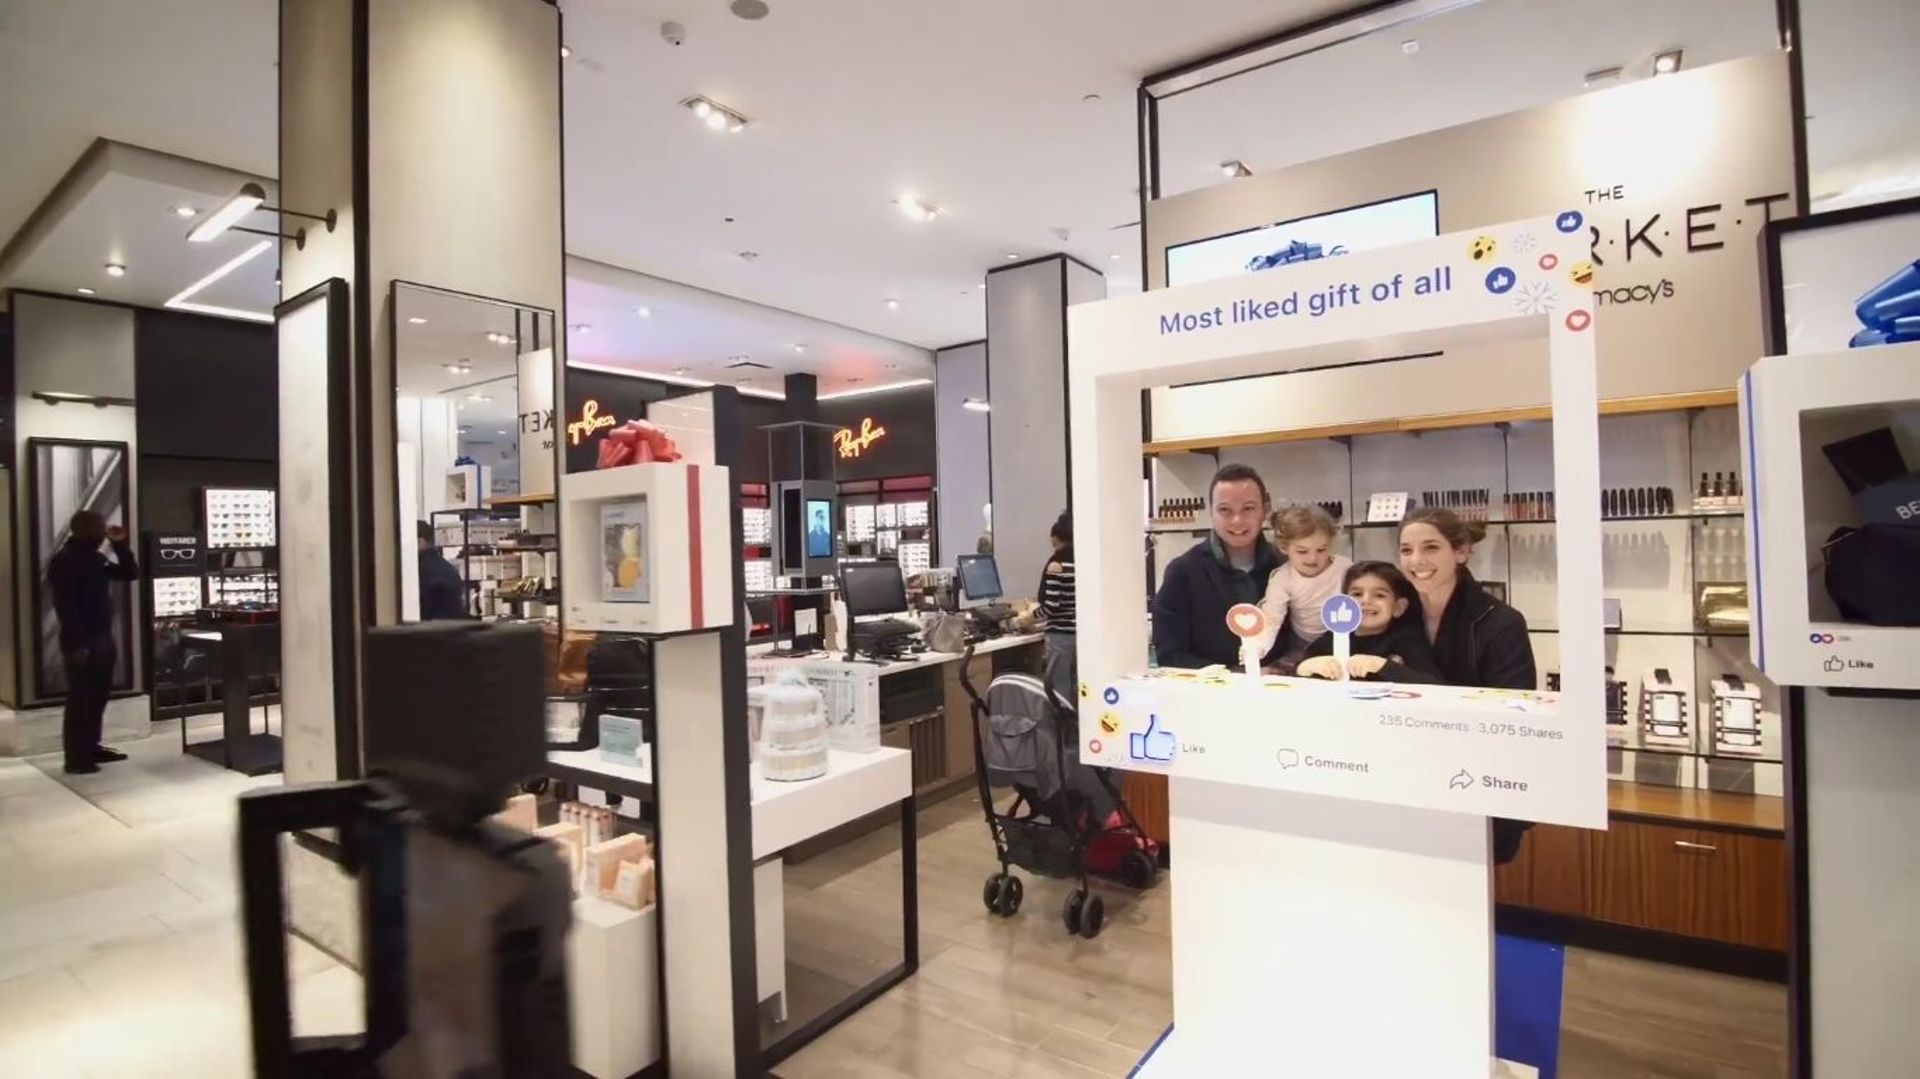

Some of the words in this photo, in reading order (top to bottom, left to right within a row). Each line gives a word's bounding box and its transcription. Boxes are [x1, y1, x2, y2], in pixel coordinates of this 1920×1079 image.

[1584, 185, 1624, 203] THE
[1160, 306, 1224, 335] Most
[1232, 292, 1298, 323] liked
[1309, 283, 1361, 316] gift
[1371, 274, 1403, 301] of
[1414, 266, 1452, 295] all
[1848, 659, 1874, 669] Like
[1378, 714, 1403, 727] 235
[1404, 716, 1470, 732] Comments
[1478, 722, 1516, 736] 3,075
[1519, 726, 1564, 740] Shares
[1181, 743, 1206, 754] Like
[1304, 755, 1370, 773] Comment
[1482, 775, 1528, 791] Share
